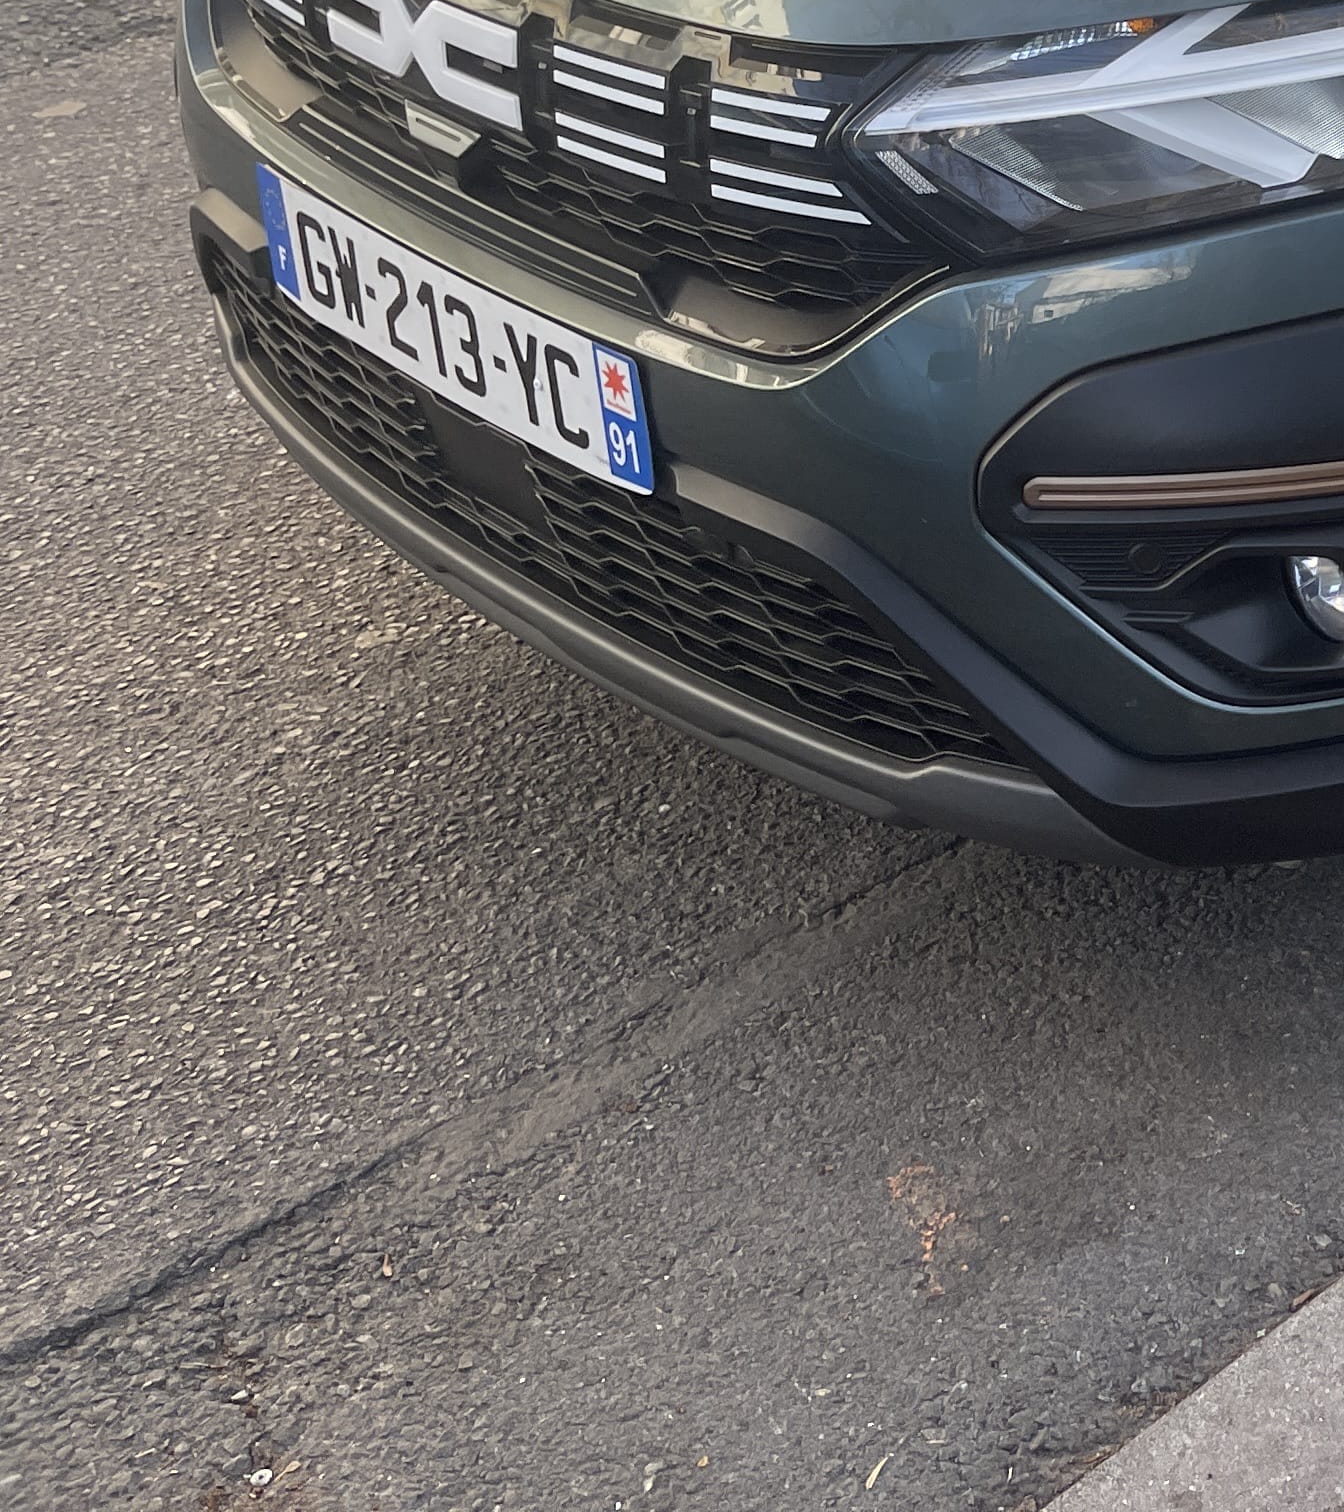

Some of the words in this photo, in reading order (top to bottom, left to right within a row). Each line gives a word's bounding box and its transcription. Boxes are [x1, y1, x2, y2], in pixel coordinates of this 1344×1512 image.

[278, 245, 287, 271] F
[297, 211, 590, 449] GW-213-YC
[608, 421, 641, 474] 91
